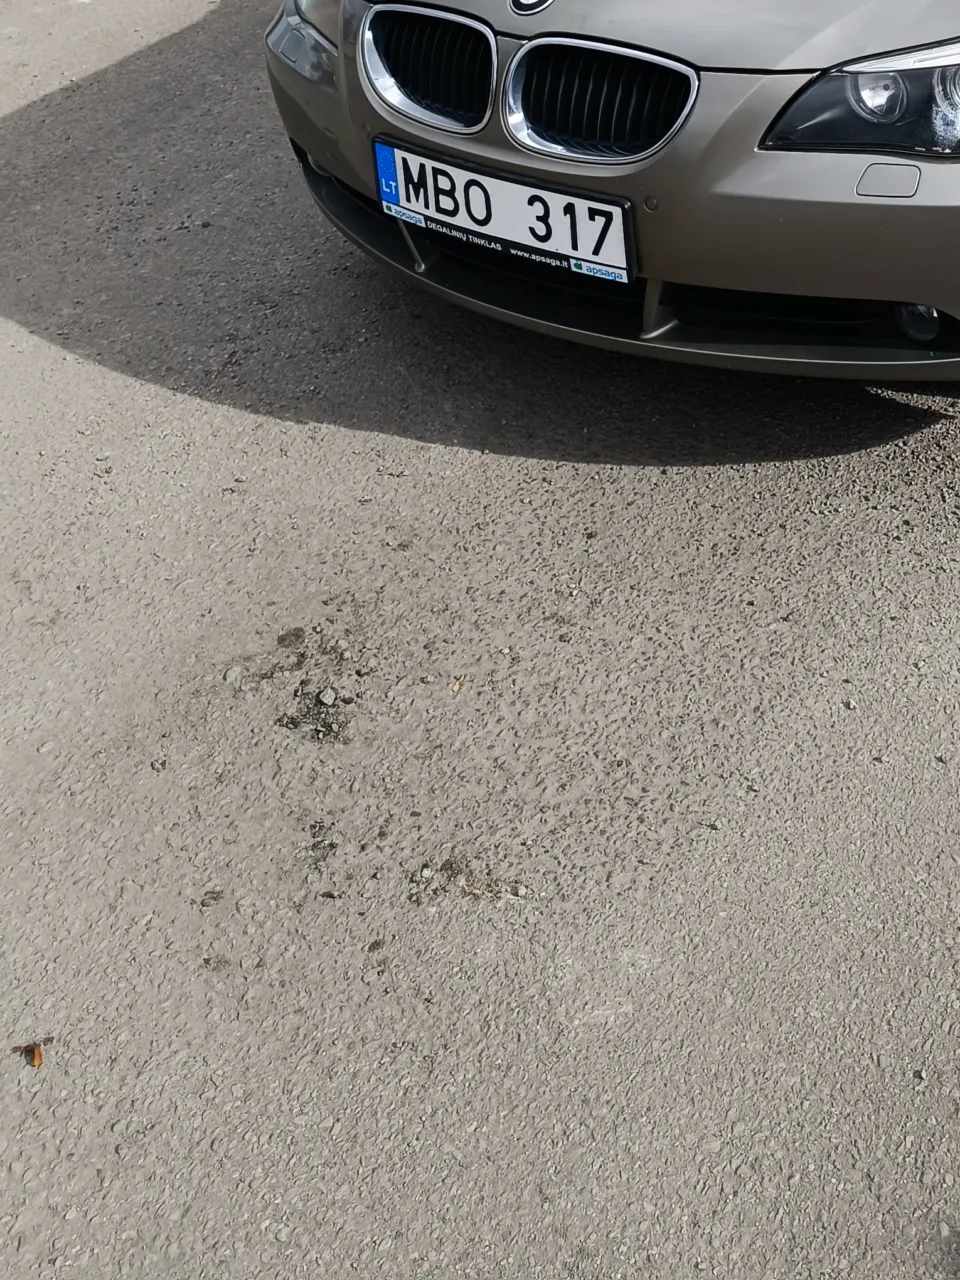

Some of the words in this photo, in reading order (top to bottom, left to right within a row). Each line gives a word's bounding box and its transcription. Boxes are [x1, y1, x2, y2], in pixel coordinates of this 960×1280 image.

[382, 179, 397, 195] LT
[401, 157, 492, 226] MBO
[527, 194, 613, 256] 317
[393, 208, 422, 225] apsaga
[468, 235, 502, 251] TINKLAS
[510, 248, 568, 269] www.apsaga.lt
[586, 266, 623, 280] apsaga
